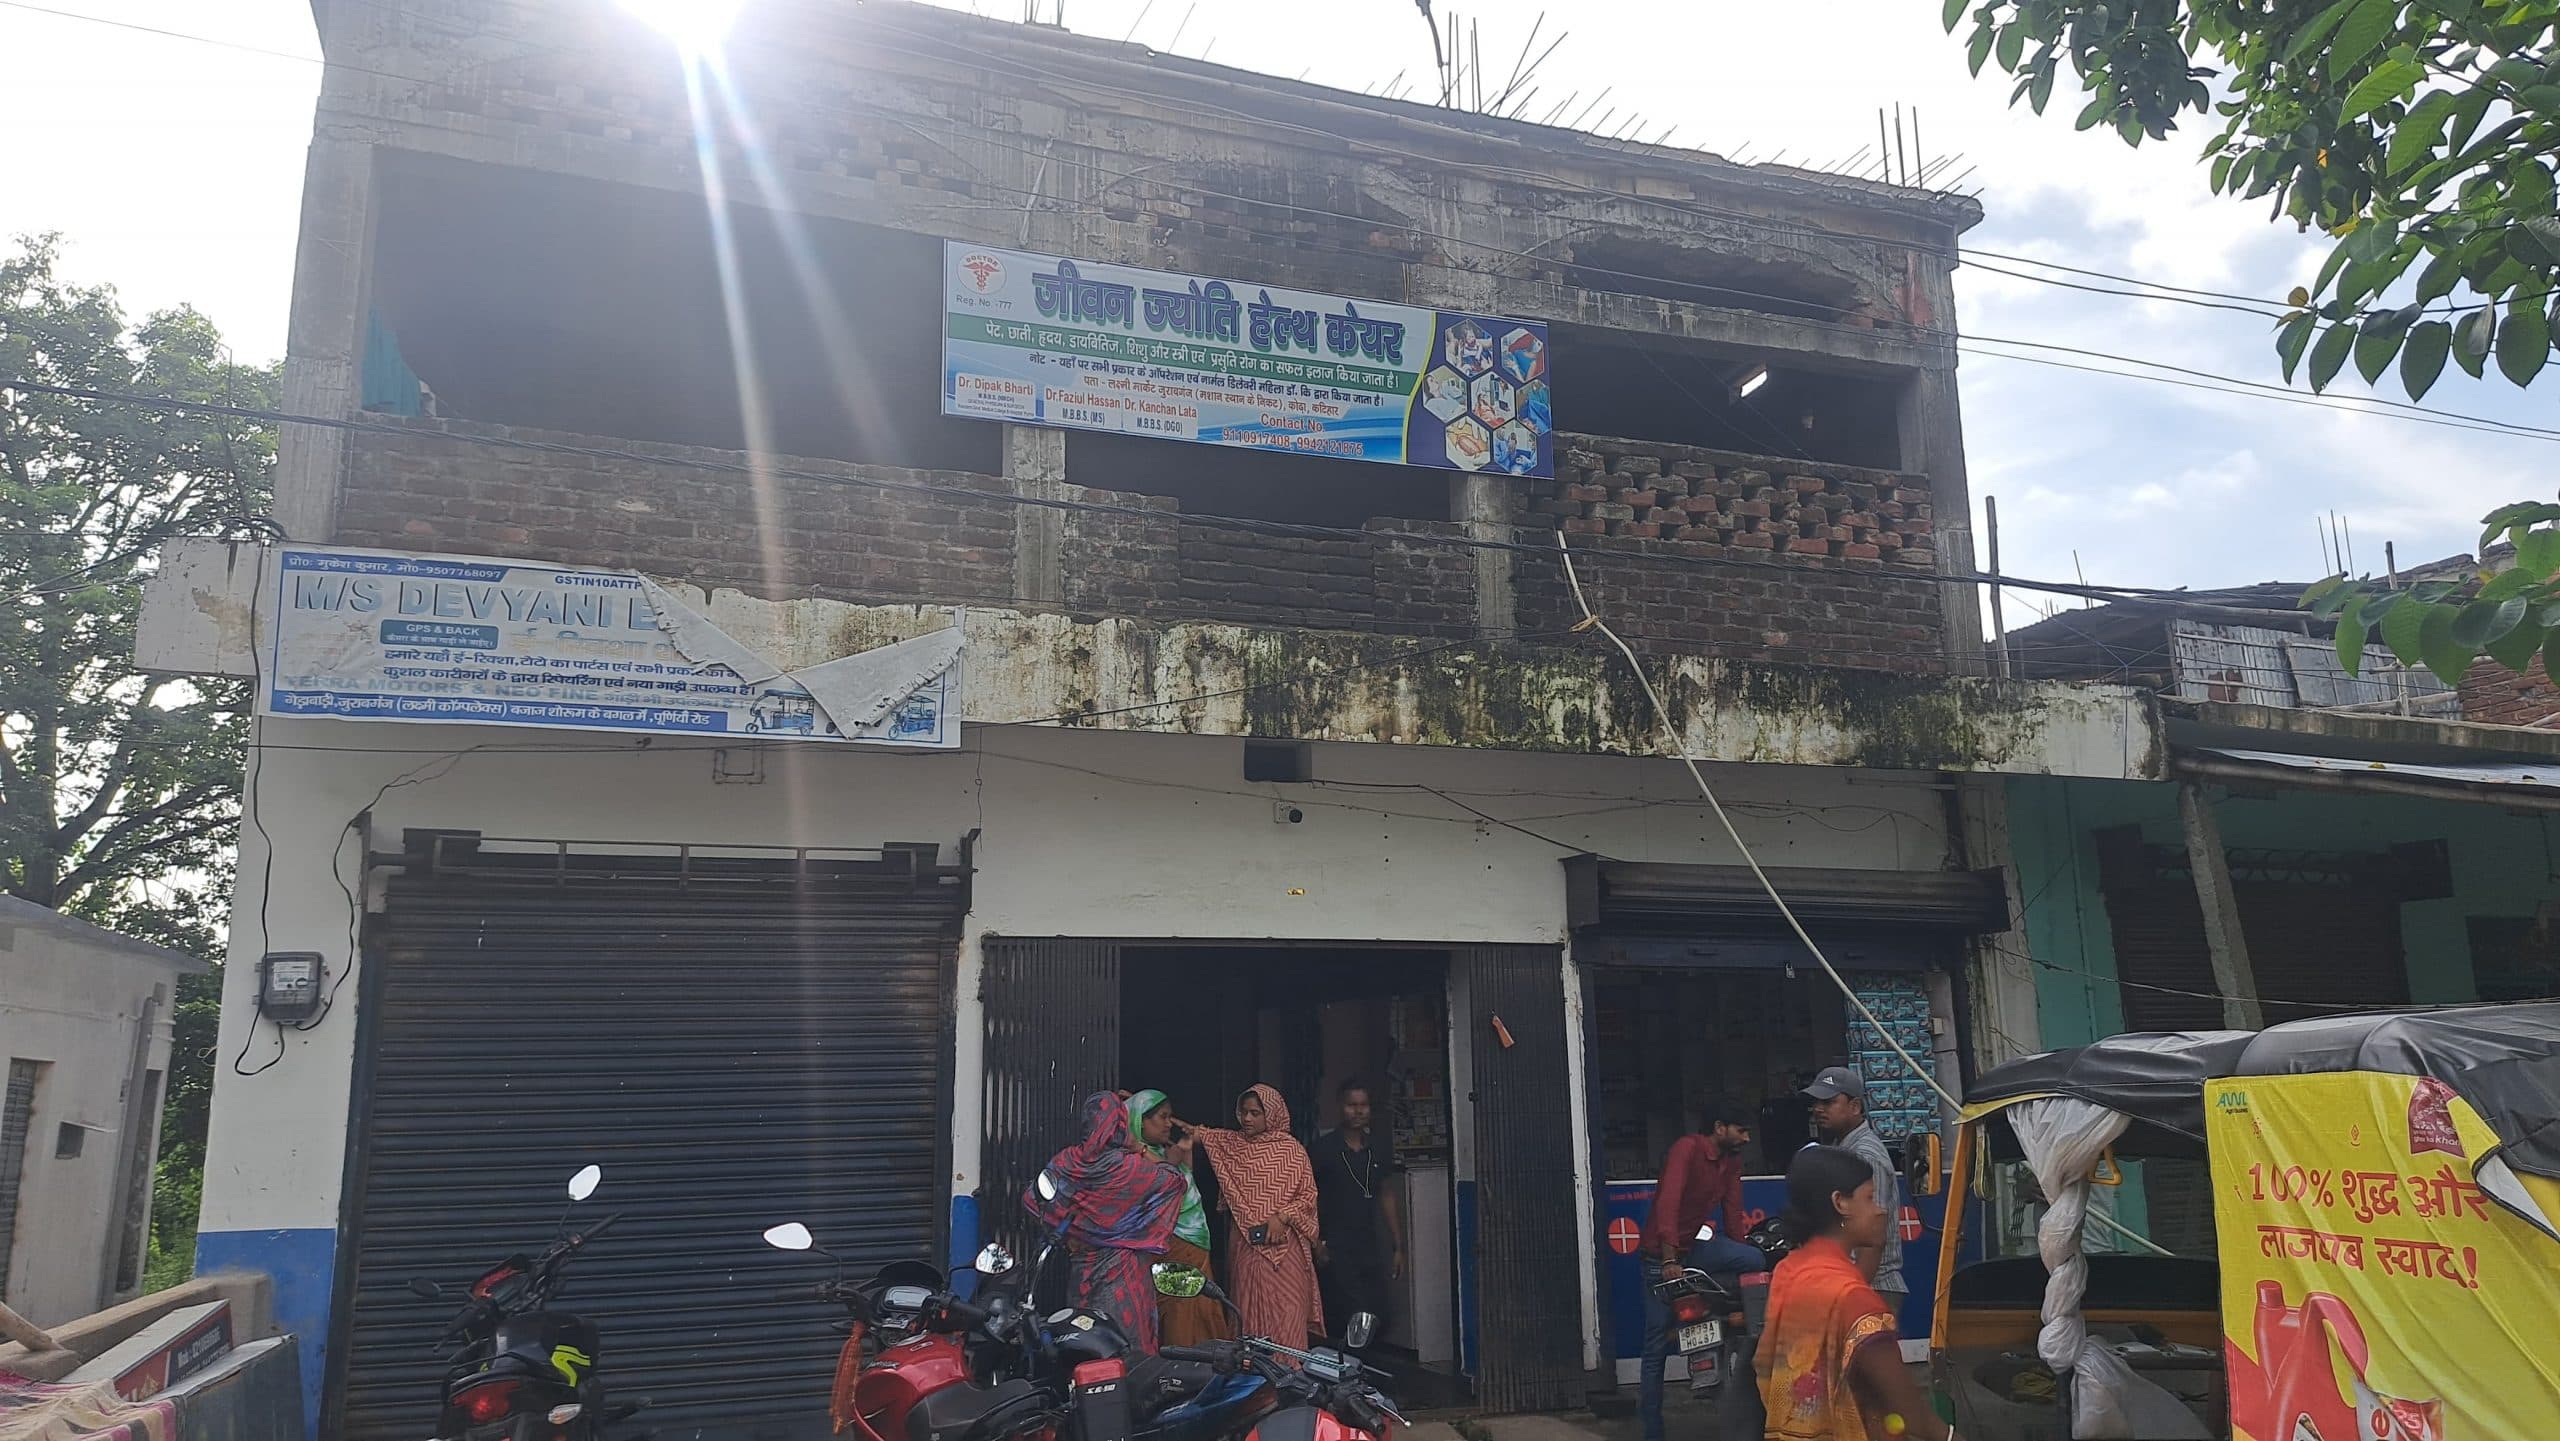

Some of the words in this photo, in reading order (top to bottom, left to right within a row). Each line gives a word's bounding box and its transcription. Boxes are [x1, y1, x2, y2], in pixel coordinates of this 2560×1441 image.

[966, 255, 998, 267] DOCTOR
[956, 294, 976, 306] Reg.
[1032, 259, 1135, 328] जीवन
[1143, 279, 1240, 343] ज्योति
[1248, 289, 1319, 355] हेल्थ
[1325, 301, 1405, 366] केयर
[985, 320, 1004, 338] पेट,
[1008, 323, 1034, 342] छाती,
[1126, 338, 1148, 362] शिशु
[1150, 342, 1169, 359] और
[1172, 344, 1188, 361] स्त्री
[1191, 348, 1206, 363] एवं
[1240, 353, 1257, 371] रोग
[1260, 359, 1274, 372] का
[1276, 360, 1303, 376] सफल
[1306, 365, 1333, 380] इलाज
[1337, 365, 1360, 383] किया
[1362, 372, 1384, 387] जाता
[1387, 371, 1399, 388] है।
[959, 376, 971, 388] Dr.
[975, 378, 1001, 392] Dipak
[1005, 382, 1034, 396] Bharti
[1029, 352, 1046, 364] नोट
[1059, 355, 1075, 368] यहाँ
[1078, 359, 1089, 370] पर
[1091, 359, 1109, 373] सभी
[1112, 364, 1134, 376] प्रकार
[1137, 364, 1146, 376] के
[1187, 372, 1200, 383] एवं
[1259, 380, 1284, 394] महिला
[1300, 384, 1312, 397] कि
[1314, 389, 1329, 400] द्वारा
[1331, 388, 1351, 401] किया
[1353, 394, 1371, 406] जाता
[1374, 393, 1384, 406] है।
[1084, 375, 1099, 387] पता
[1088, 393, 1120, 408] Hassan
[1125, 398, 1136, 411] Dr.
[1139, 402, 1176, 417] Kanchan
[1179, 406, 1197, 418] Lata
[1062, 408, 1090, 423] M.B.B.S.
[1091, 411, 1105, 426] (MS)
[1137, 418, 1163, 431] M.B.B.S.
[1164, 421, 1183, 435] (DGO)
[1261, 413, 1304, 430] Contact
[1308, 419, 1325, 433] No.
[294, 574, 384, 612] M/S
[399, 580, 613, 627] DEVYANI
[406, 623, 431, 633] GPS
[434, 625, 442, 633] &
[446, 626, 480, 636] BACK
[385, 649, 421, 661] हमारे
[551, 659, 569, 668] का
[613, 661, 631, 672] एवं
[635, 664, 663, 676] सभी
[367, 678, 464, 693] MOTORS
[549, 687, 599, 701] FINE
[383, 666, 427, 679] कुशल
[429, 667, 489, 681] कारीगरों
[492, 670, 507, 681] के
[511, 673, 539, 684] द्वारा
[604, 676, 624, 688] एवं
[627, 679, 653, 690] नया
[656, 680, 686, 694] गाड़ी
[739, 684, 755, 696] है।
[588, 706, 601, 719] के
[691, 713, 711, 725] रोड
[2248, 1162, 2335, 1208] 100%
[2342, 1169, 2401, 1224] शुद्ध
[2407, 1164, 2489, 1222] और
[2374, 1237, 2479, 1290] स्वाद!
